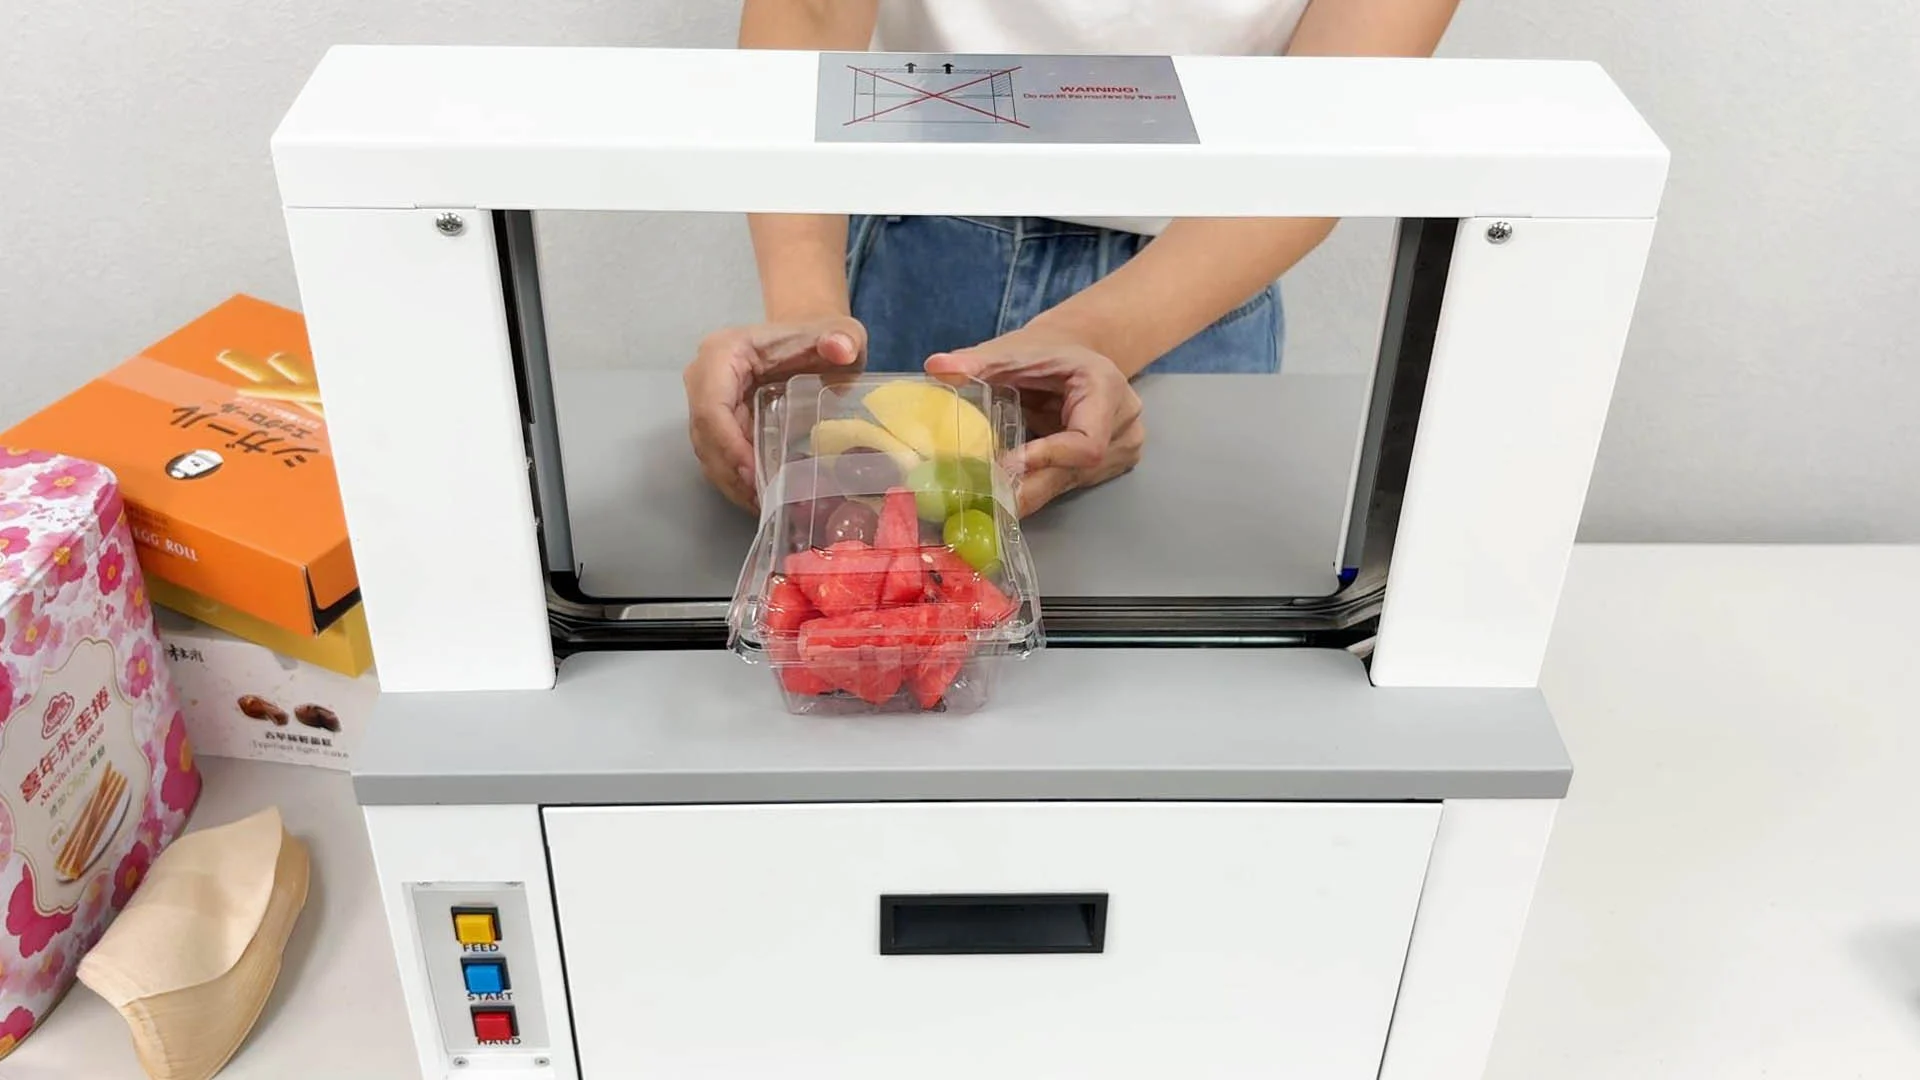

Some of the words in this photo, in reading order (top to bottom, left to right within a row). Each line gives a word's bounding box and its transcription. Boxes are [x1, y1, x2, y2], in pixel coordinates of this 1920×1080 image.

[170, 406, 320, 468] シガール
[165, 536, 199, 562] ROLL
[463, 943, 499, 952] FEED
[467, 992, 513, 1001] START
[477, 1037, 521, 1045] HAND
